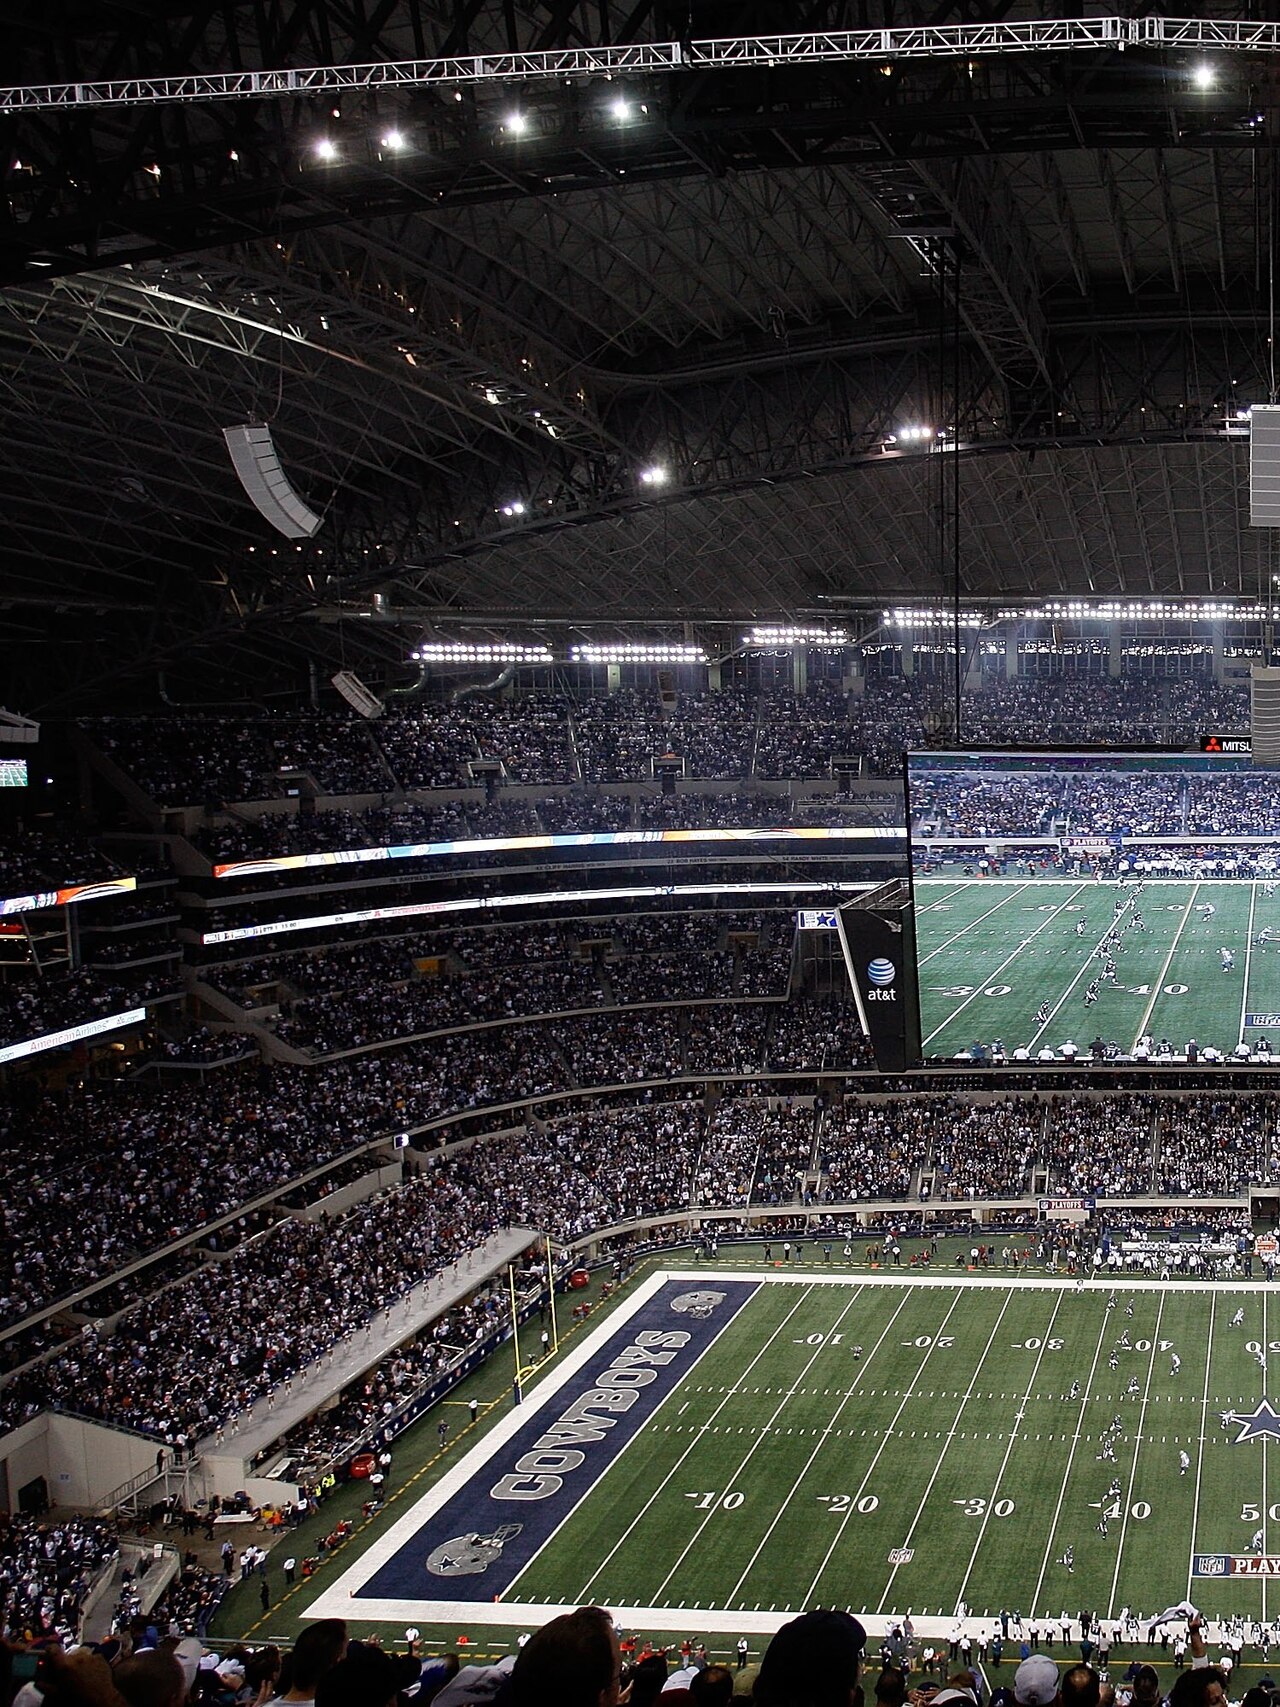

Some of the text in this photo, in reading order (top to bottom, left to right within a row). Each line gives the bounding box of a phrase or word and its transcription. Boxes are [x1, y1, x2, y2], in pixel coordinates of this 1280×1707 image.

[1222, 742, 1252, 752] MITSU
[868, 988, 896, 1001] at&t
[1127, 983, 1190, 995] 40
[1051, 1201, 1082, 1210] PLAYOFFS
[489, 1330, 692, 1500] COWBOYS
[694, 1492, 746, 1510] 10
[827, 1494, 880, 1513] 20
[963, 1498, 1016, 1517] 30
[1103, 1501, 1152, 1520] 40
[1202, 1562, 1223, 1573] NFL
